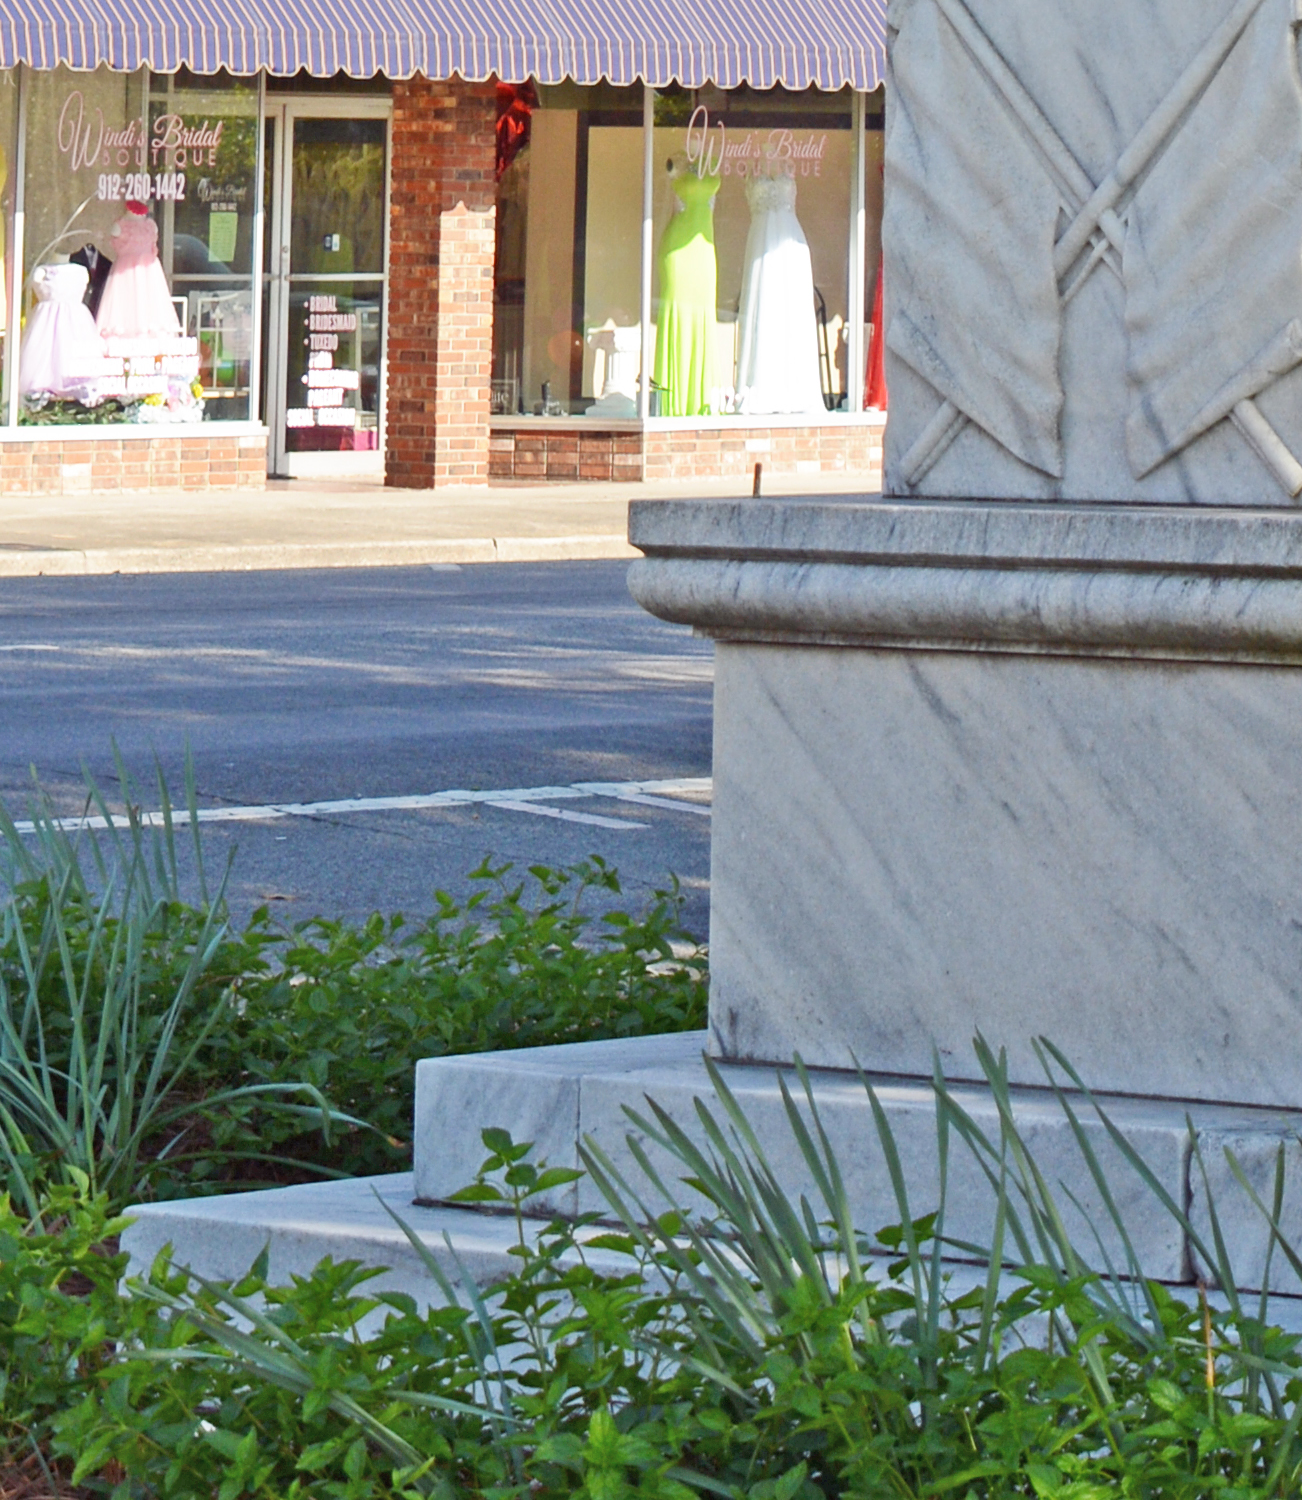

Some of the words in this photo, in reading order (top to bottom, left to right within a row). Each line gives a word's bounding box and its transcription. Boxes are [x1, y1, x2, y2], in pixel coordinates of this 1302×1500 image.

[152, 114, 223, 150] Bridal
[766, 129, 828, 160] Bridal
[102, 149, 217, 168] BOUTIQUE
[724, 160, 822, 178] BOUTIQUE
[98, 173, 186, 200] 912-260-1442
